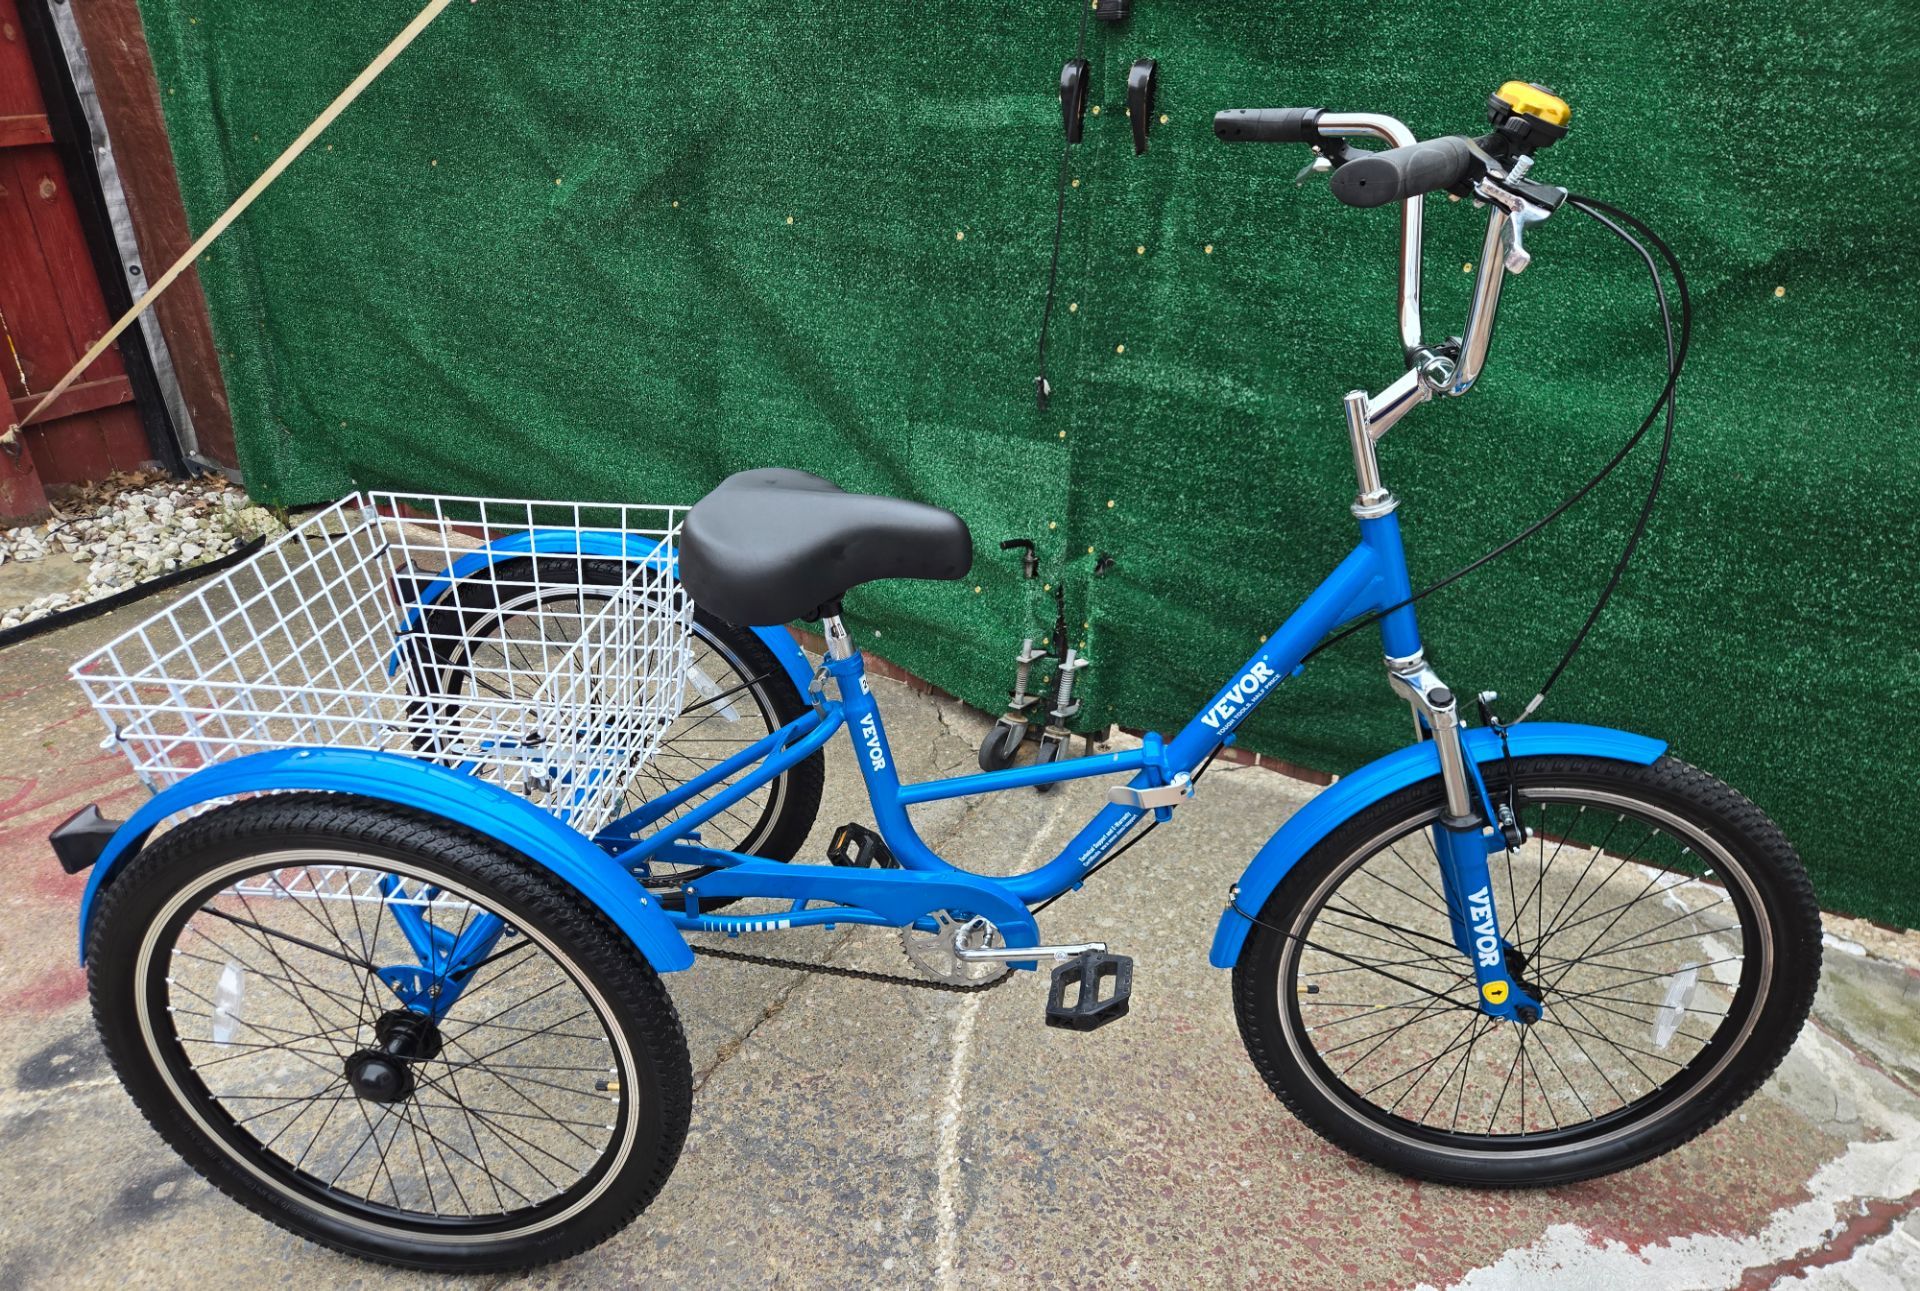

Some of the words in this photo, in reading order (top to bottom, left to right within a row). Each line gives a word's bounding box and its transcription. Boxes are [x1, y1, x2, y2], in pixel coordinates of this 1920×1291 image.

[1200, 661, 1275, 729] VEVOR
[1264, 673, 1281, 690] PRICE
[860, 712, 886, 772] VEVOR
[1105, 828, 1115, 837] and
[1468, 885, 1500, 968] VEVOR
